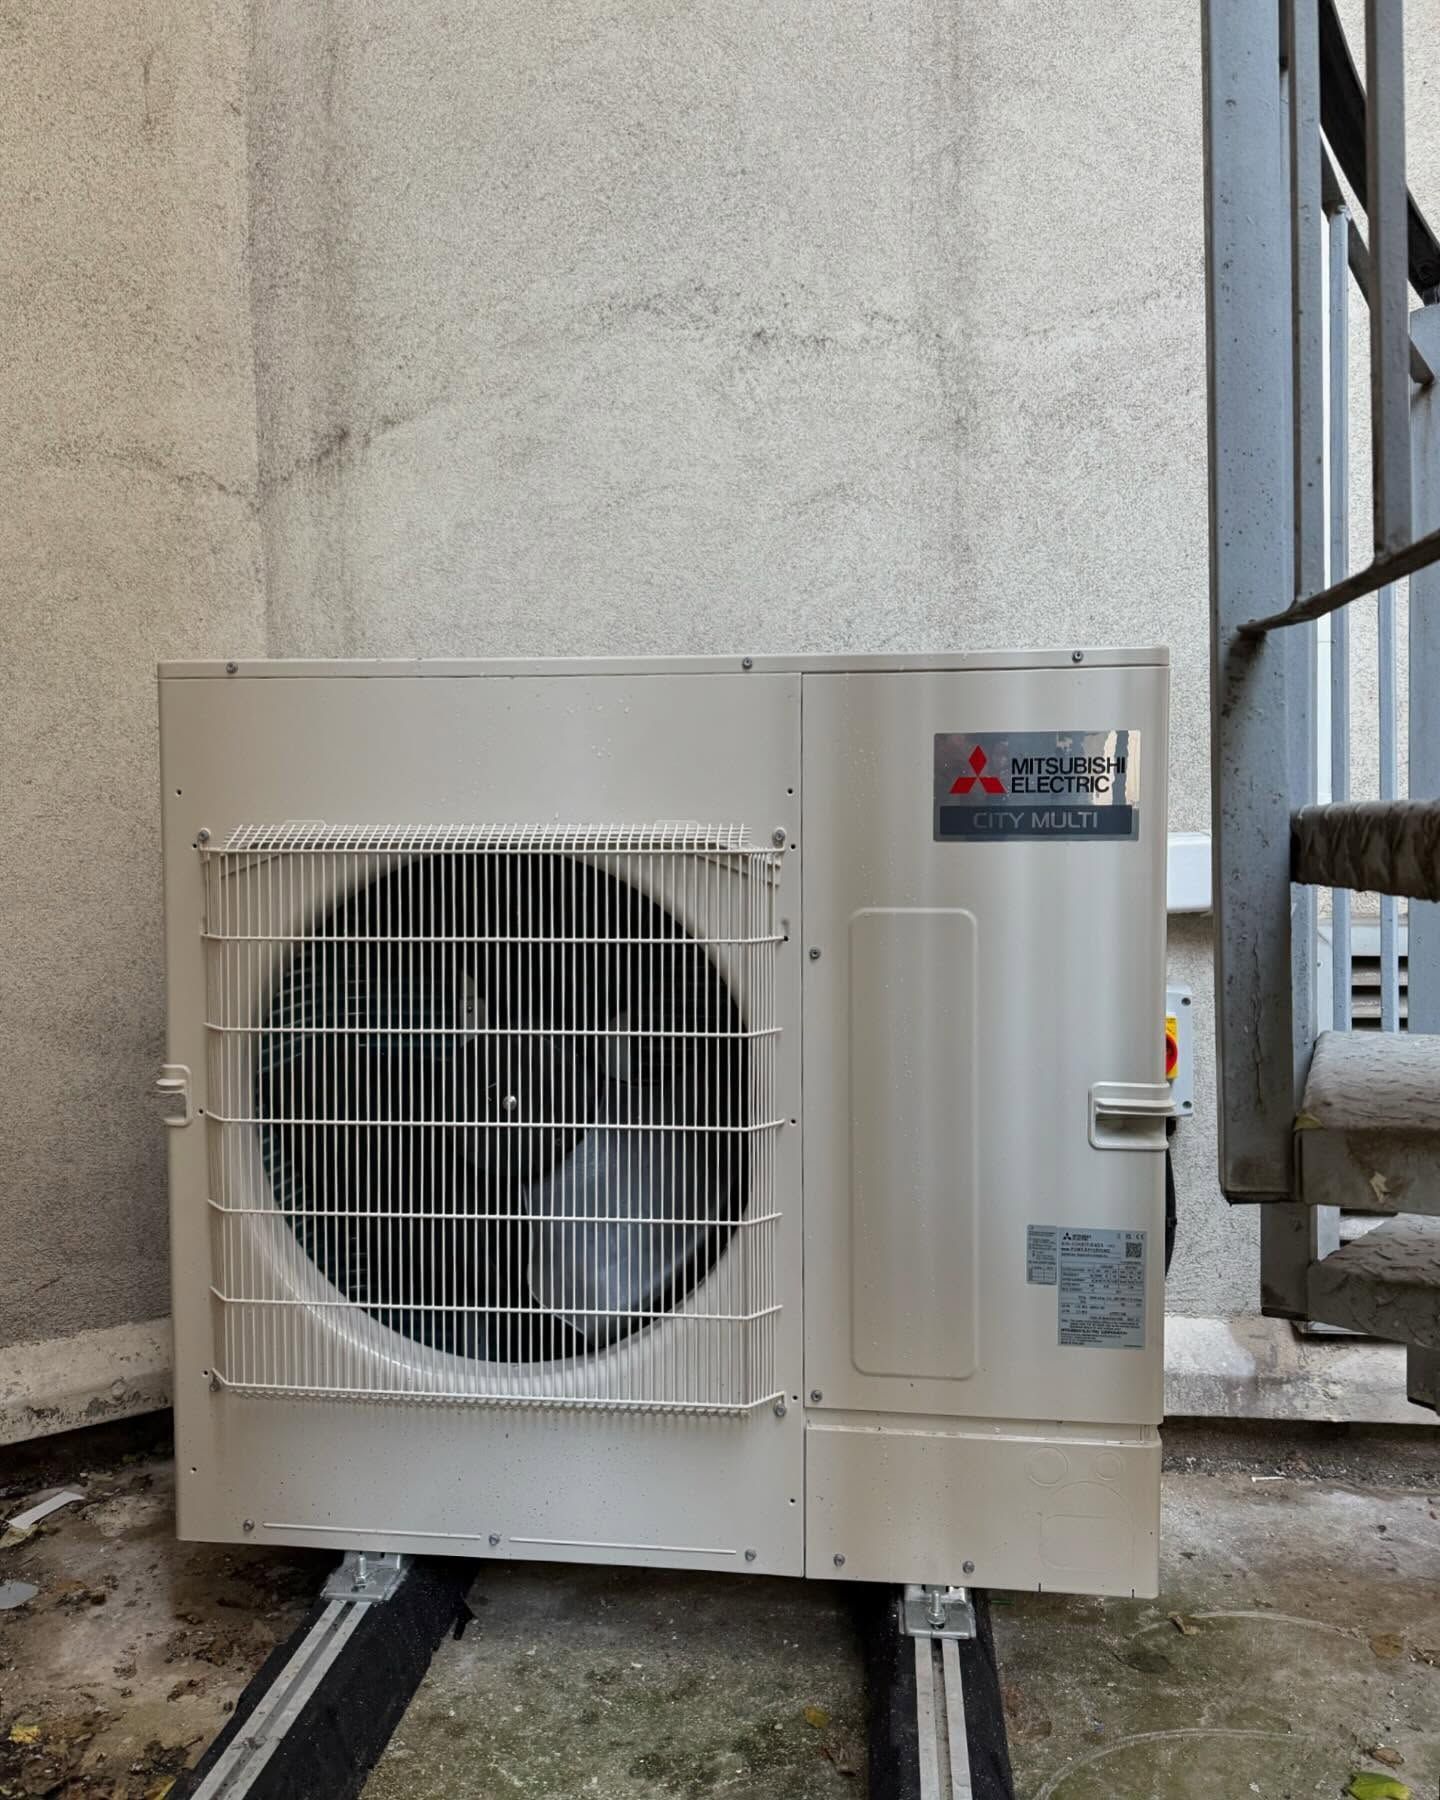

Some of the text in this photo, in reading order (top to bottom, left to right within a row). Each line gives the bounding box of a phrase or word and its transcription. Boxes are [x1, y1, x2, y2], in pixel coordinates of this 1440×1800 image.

[1011, 757, 1126, 775] MITSUBISHI
[1011, 776, 1110, 794] ELECTRIC
[973, 811, 1098, 829] CITY MULTI
